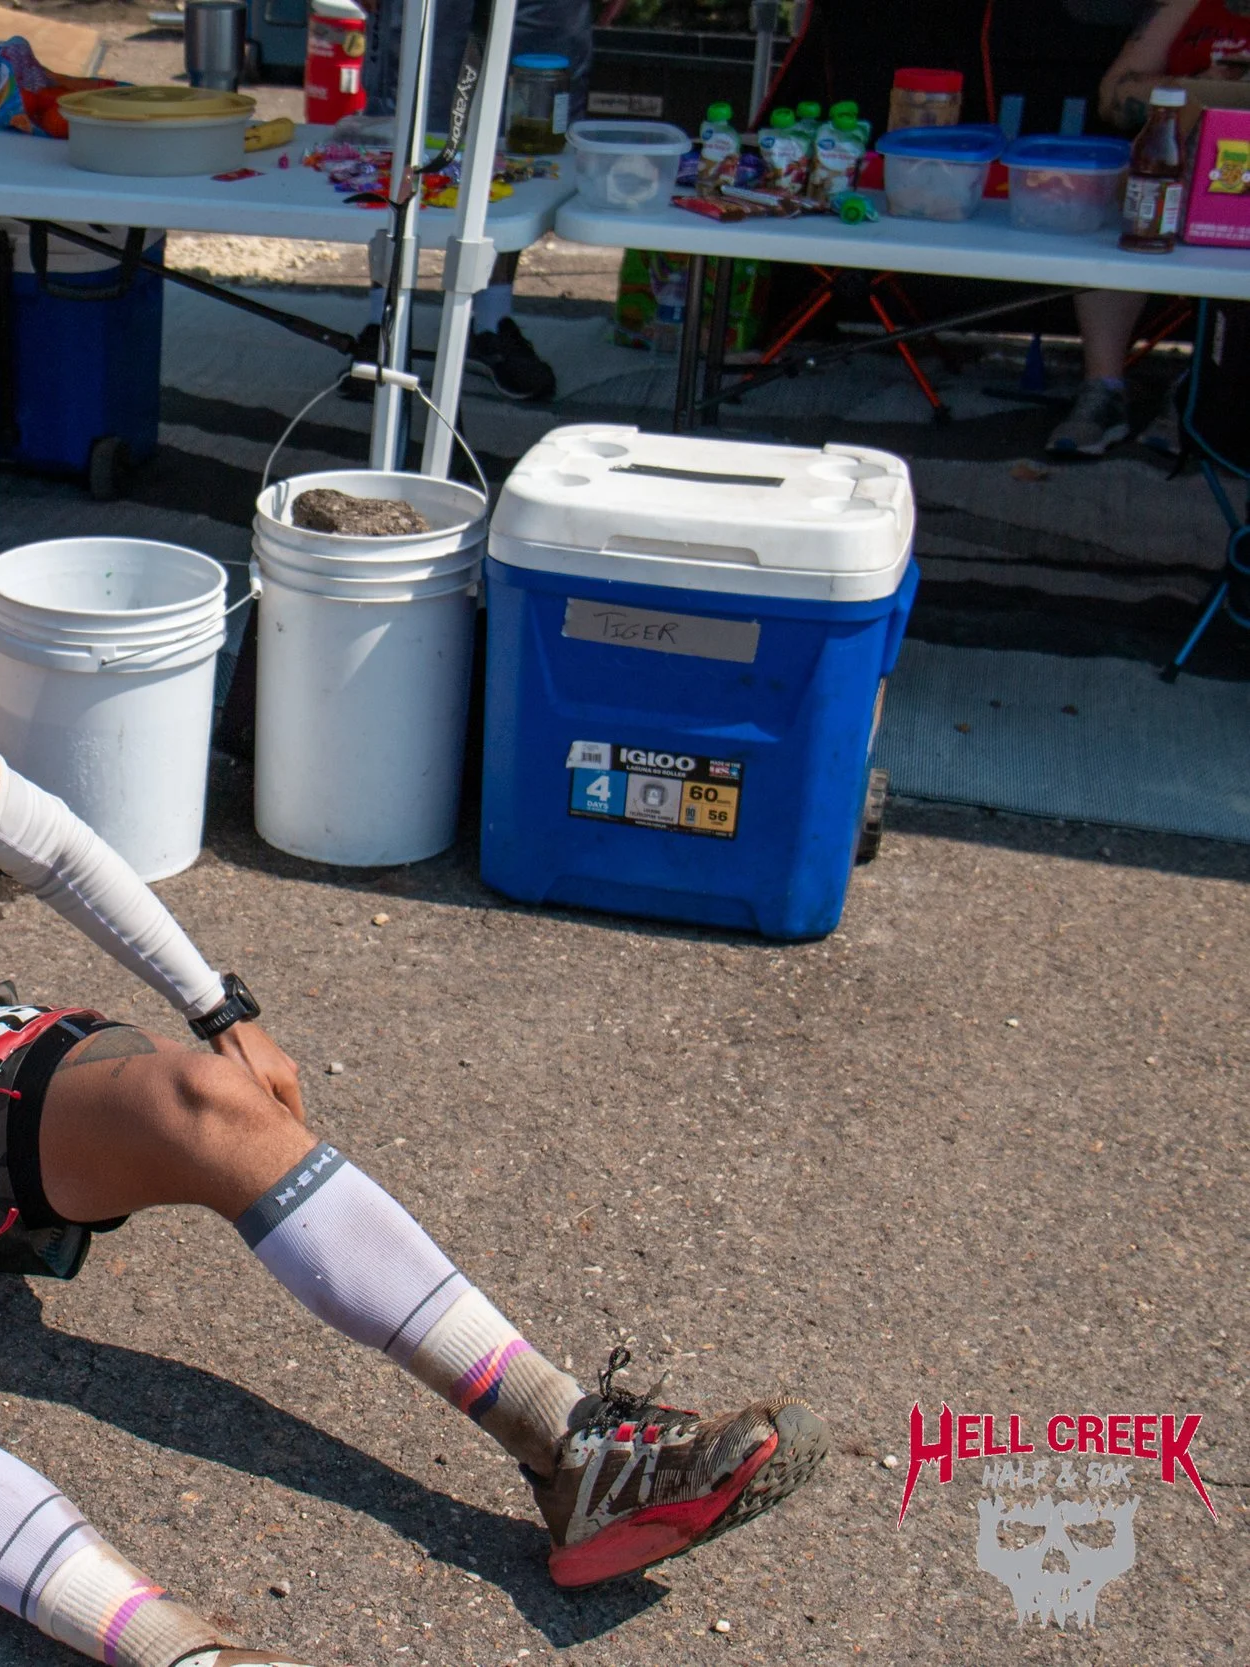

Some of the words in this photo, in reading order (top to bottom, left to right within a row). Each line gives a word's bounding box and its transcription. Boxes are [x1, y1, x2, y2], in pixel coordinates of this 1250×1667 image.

[593, 612, 680, 645] TIGER
[619, 747, 697, 772] IGLOO
[586, 775, 611, 802] 4
[689, 785, 719, 803] 60
[586, 799, 610, 810] DAYS
[707, 809, 729, 823] 56
